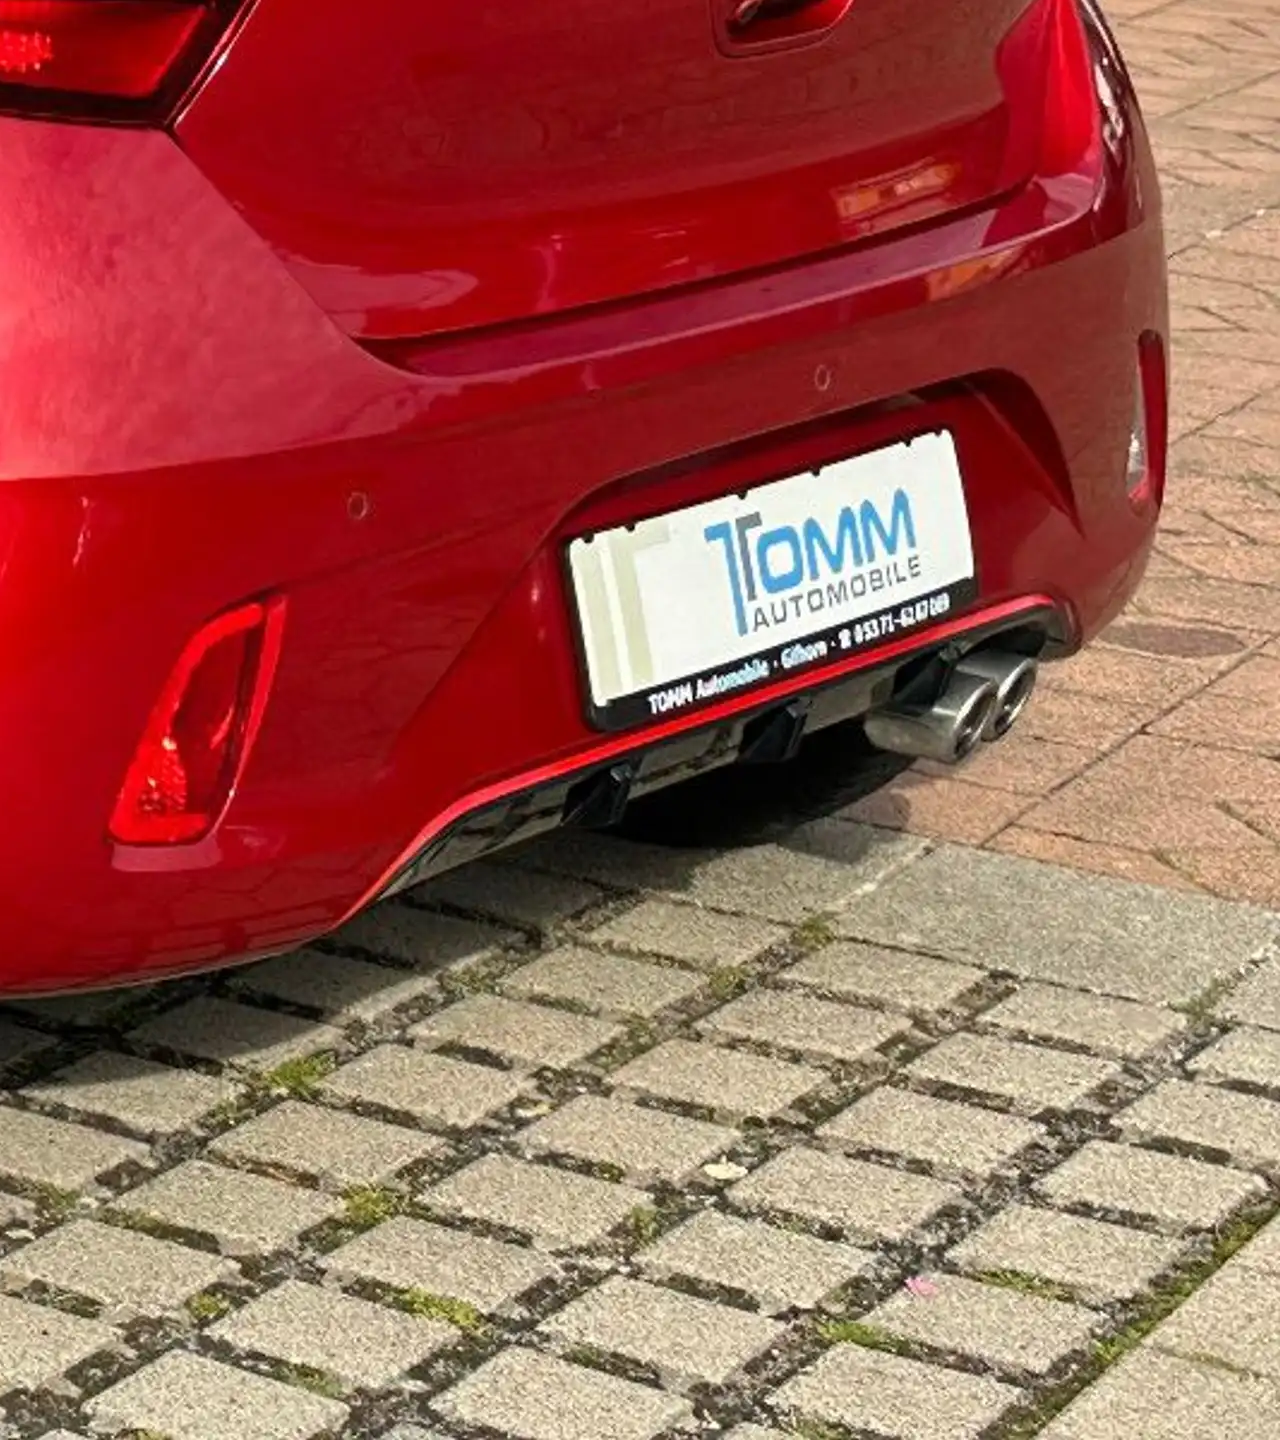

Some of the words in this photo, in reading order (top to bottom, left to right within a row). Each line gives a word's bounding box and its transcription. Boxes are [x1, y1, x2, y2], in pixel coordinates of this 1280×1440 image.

[703, 487, 916, 637] TOMM
[752, 554, 922, 632] AUTOMOBILE
[648, 681, 693, 714] TOMM
[696, 658, 770, 700] Automobile
